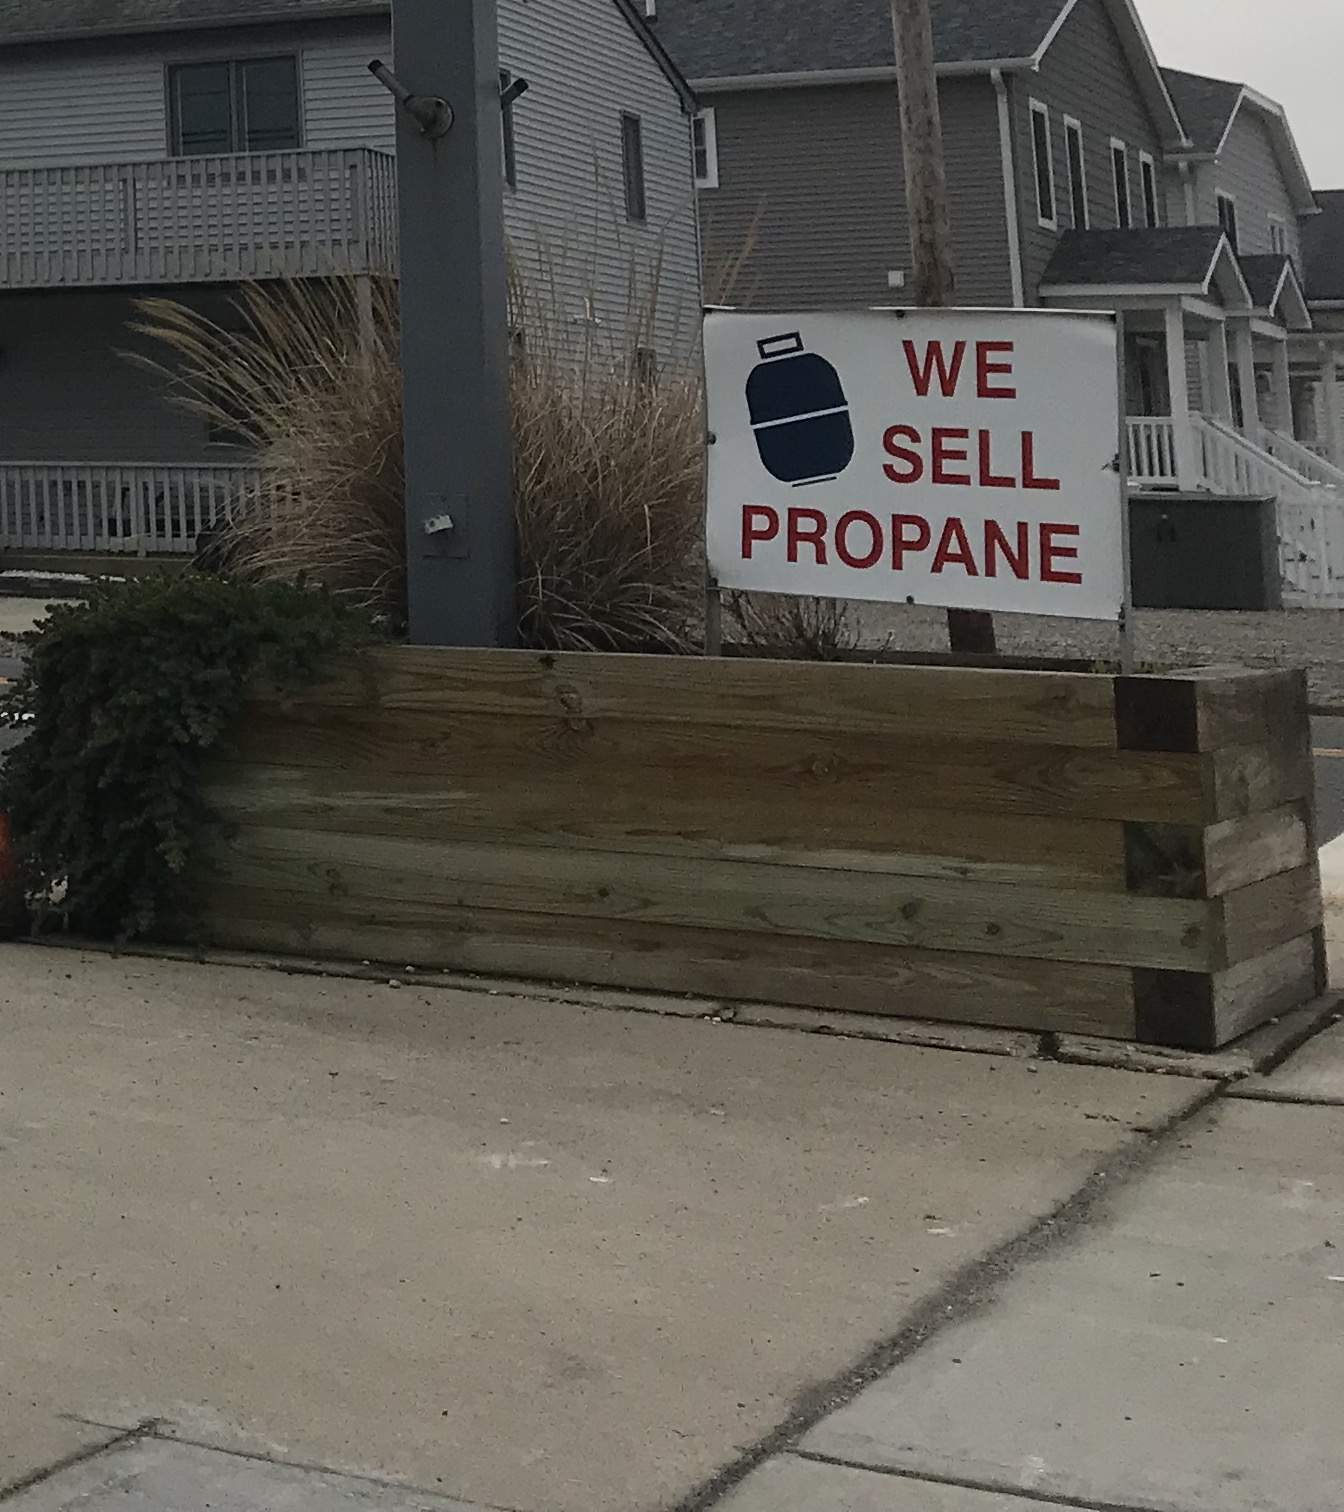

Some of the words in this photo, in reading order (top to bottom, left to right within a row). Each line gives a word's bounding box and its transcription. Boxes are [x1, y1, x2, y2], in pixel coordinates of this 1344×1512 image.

[901, 339, 1017, 399] WE
[881, 424, 1061, 490] SELL
[741, 504, 1084, 585] PROPANE
